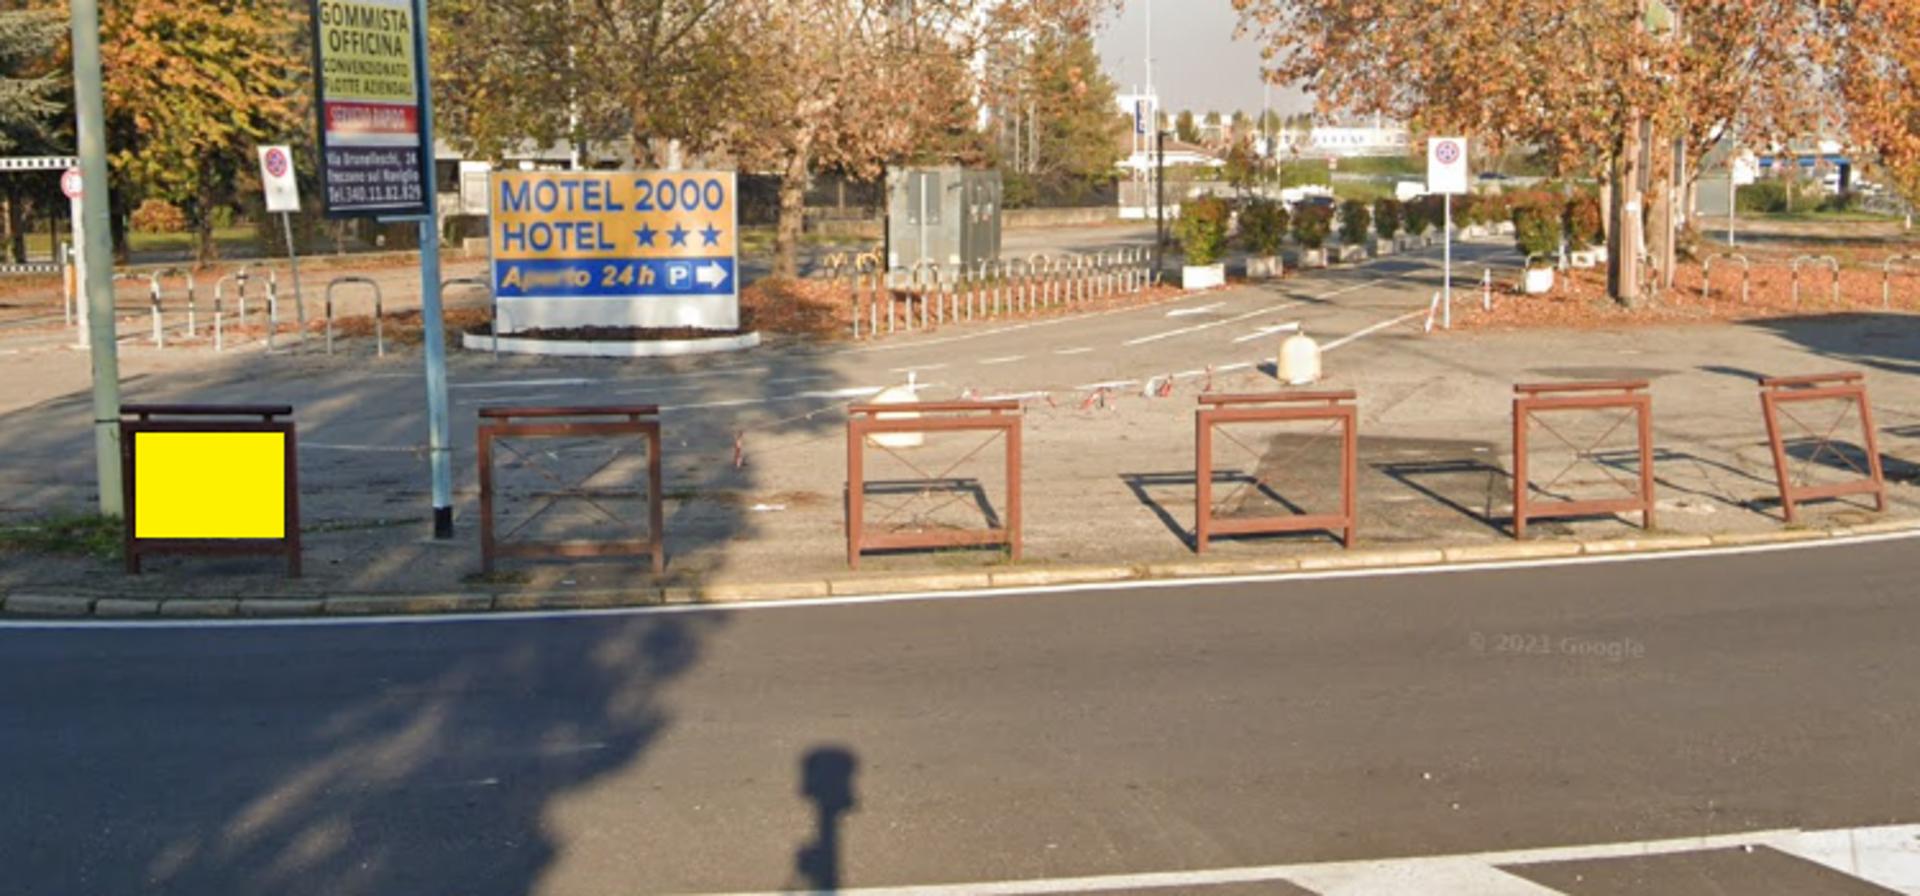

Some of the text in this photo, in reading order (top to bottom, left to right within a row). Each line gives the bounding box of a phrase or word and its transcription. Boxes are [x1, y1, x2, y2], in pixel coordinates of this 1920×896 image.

[319, 2, 409, 33] GOMMISTA
[329, 29, 404, 57] OFFICINA
[501, 178, 724, 212] MOTEL 2000
[503, 222, 615, 251] HOTEL
[602, 265, 634, 286] 24
[638, 265, 656, 286] h
[669, 266, 689, 285] P
